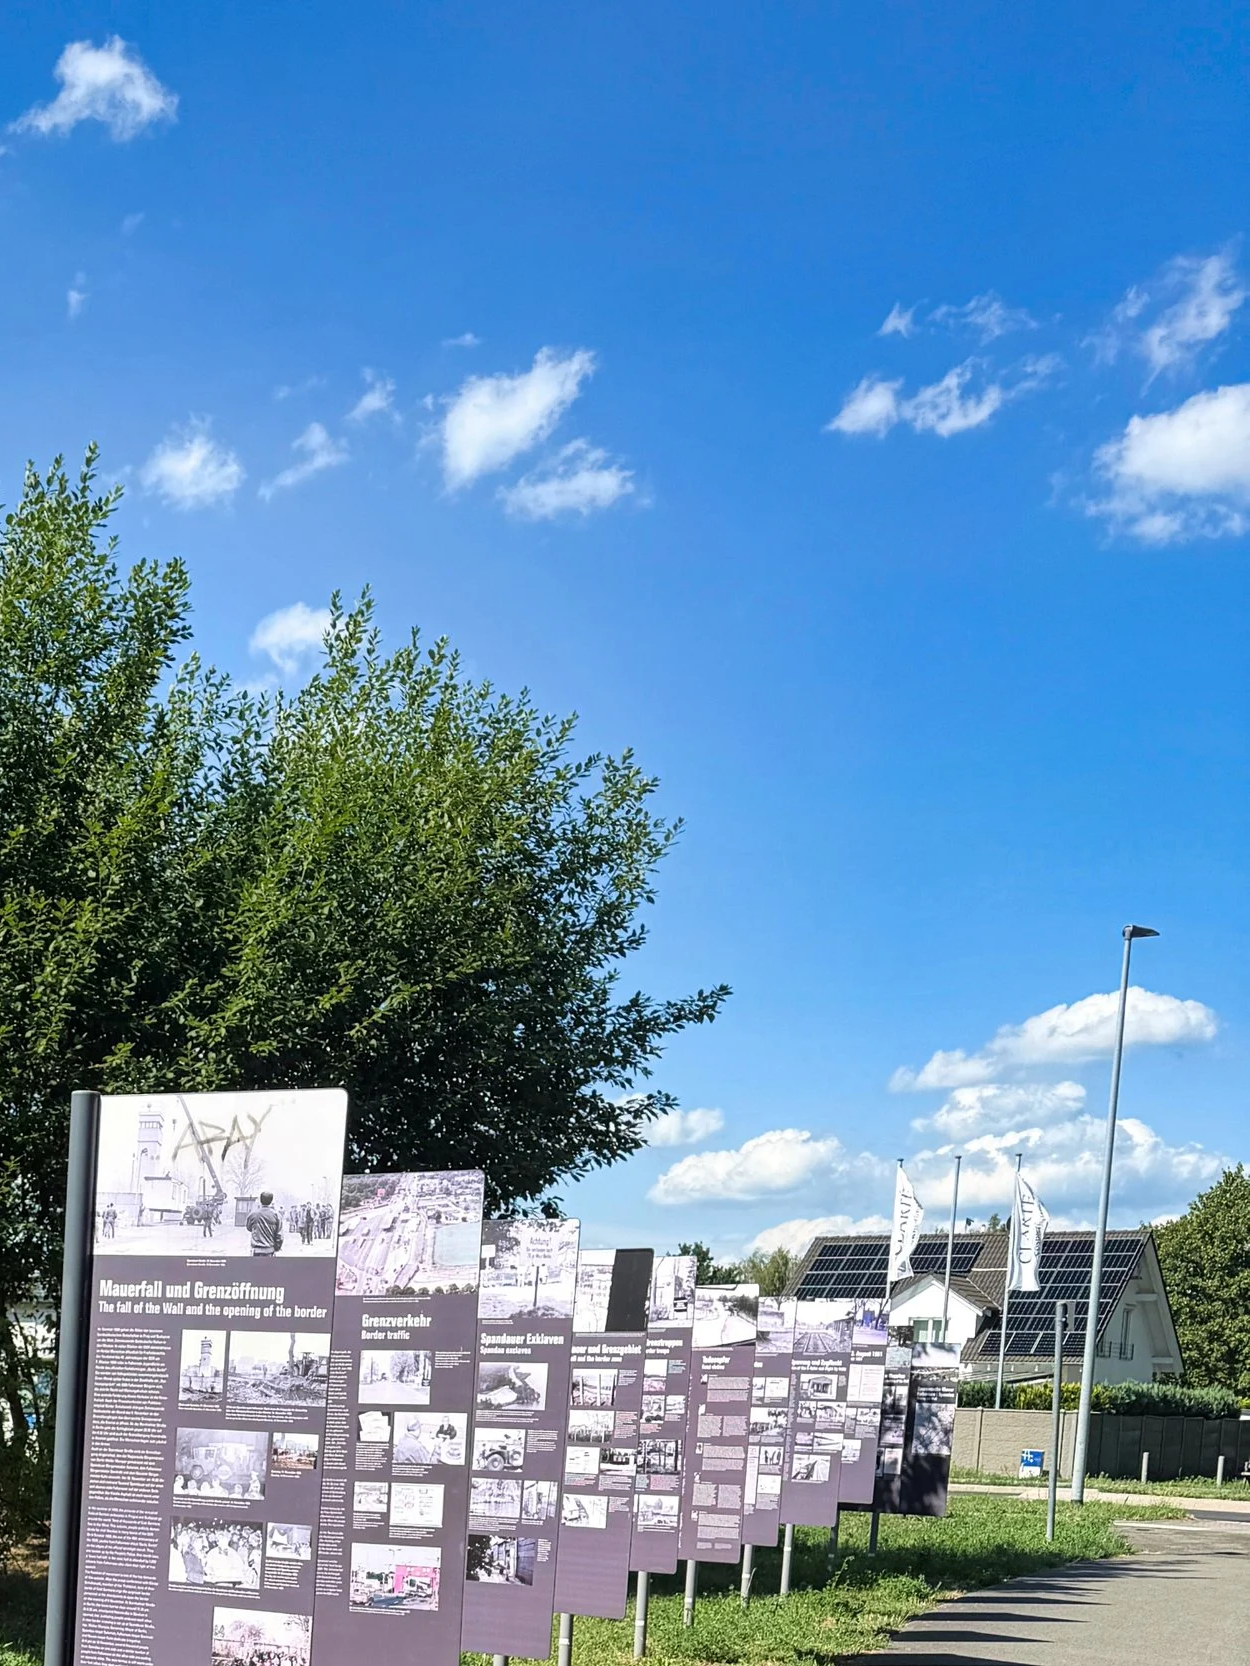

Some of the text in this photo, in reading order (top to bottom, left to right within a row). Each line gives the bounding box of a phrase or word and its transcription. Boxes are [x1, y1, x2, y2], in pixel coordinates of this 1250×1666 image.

[99, 1280, 284, 1303] Mauerfall und Grenzöffnung
[99, 1301, 327, 1320] The fall of the Wall and the opening of the border
[362, 1314, 432, 1327] Grenzverkehr
[361, 1330, 410, 1339] Border traffic
[480, 1333, 564, 1346] Spandauer Exklaven
